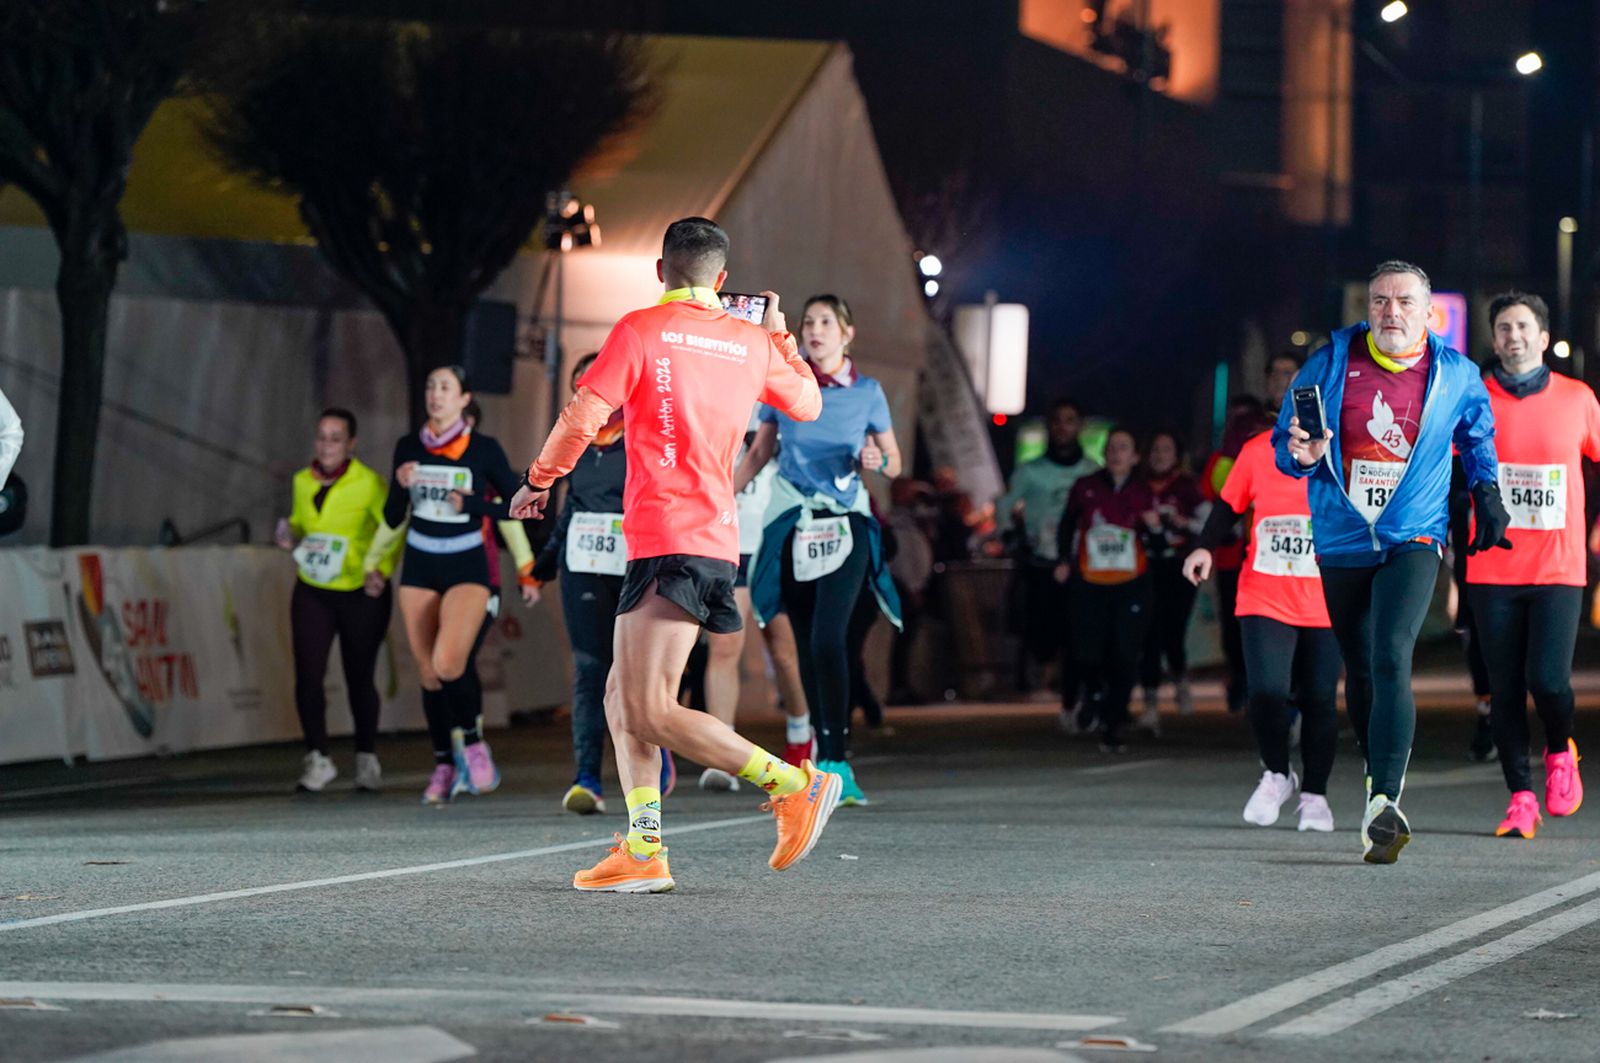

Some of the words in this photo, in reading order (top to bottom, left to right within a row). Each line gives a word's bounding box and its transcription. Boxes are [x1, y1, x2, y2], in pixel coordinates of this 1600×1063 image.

[661, 331, 684, 344] LOS
[656, 357, 672, 393] 2026
[1381, 429, 1402, 449] 43
[659, 442, 677, 468] San
[1359, 476, 1374, 485] SAN
[1511, 487, 1555, 508] 5436
[576, 534, 617, 553] 4583
[1271, 534, 1313, 556] 5437
